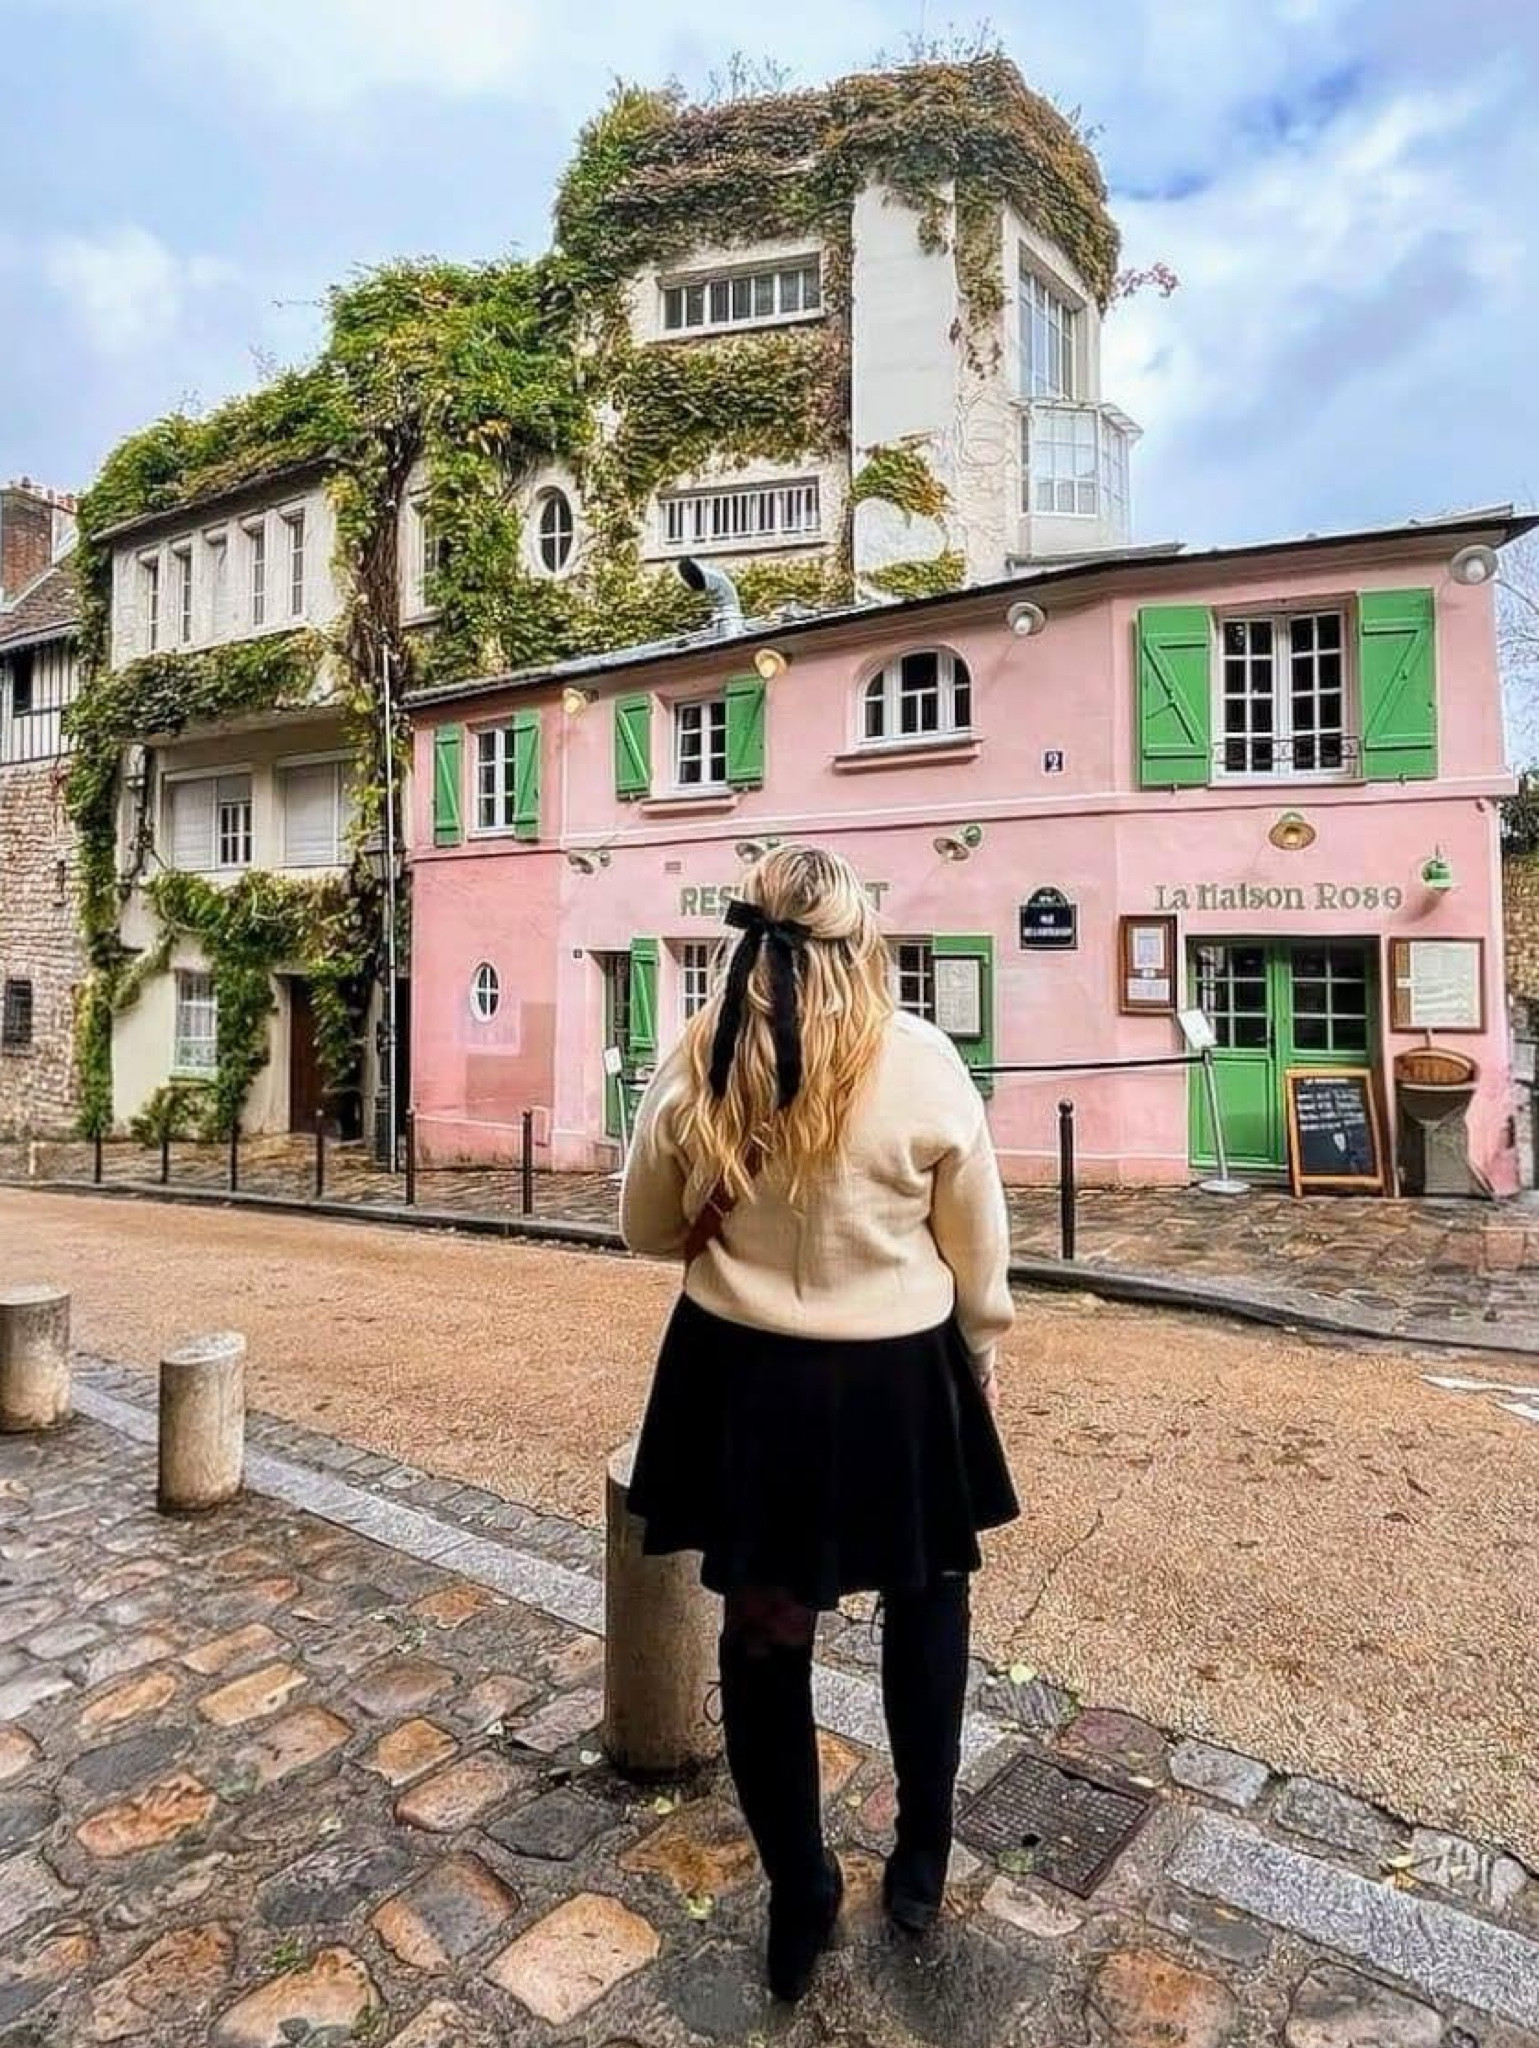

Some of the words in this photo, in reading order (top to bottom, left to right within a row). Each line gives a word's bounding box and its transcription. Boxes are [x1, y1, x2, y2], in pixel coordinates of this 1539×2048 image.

[1154, 885, 1190, 910] La
[1196, 883, 1306, 910] Maison
[1314, 882, 1402, 910] Rose
